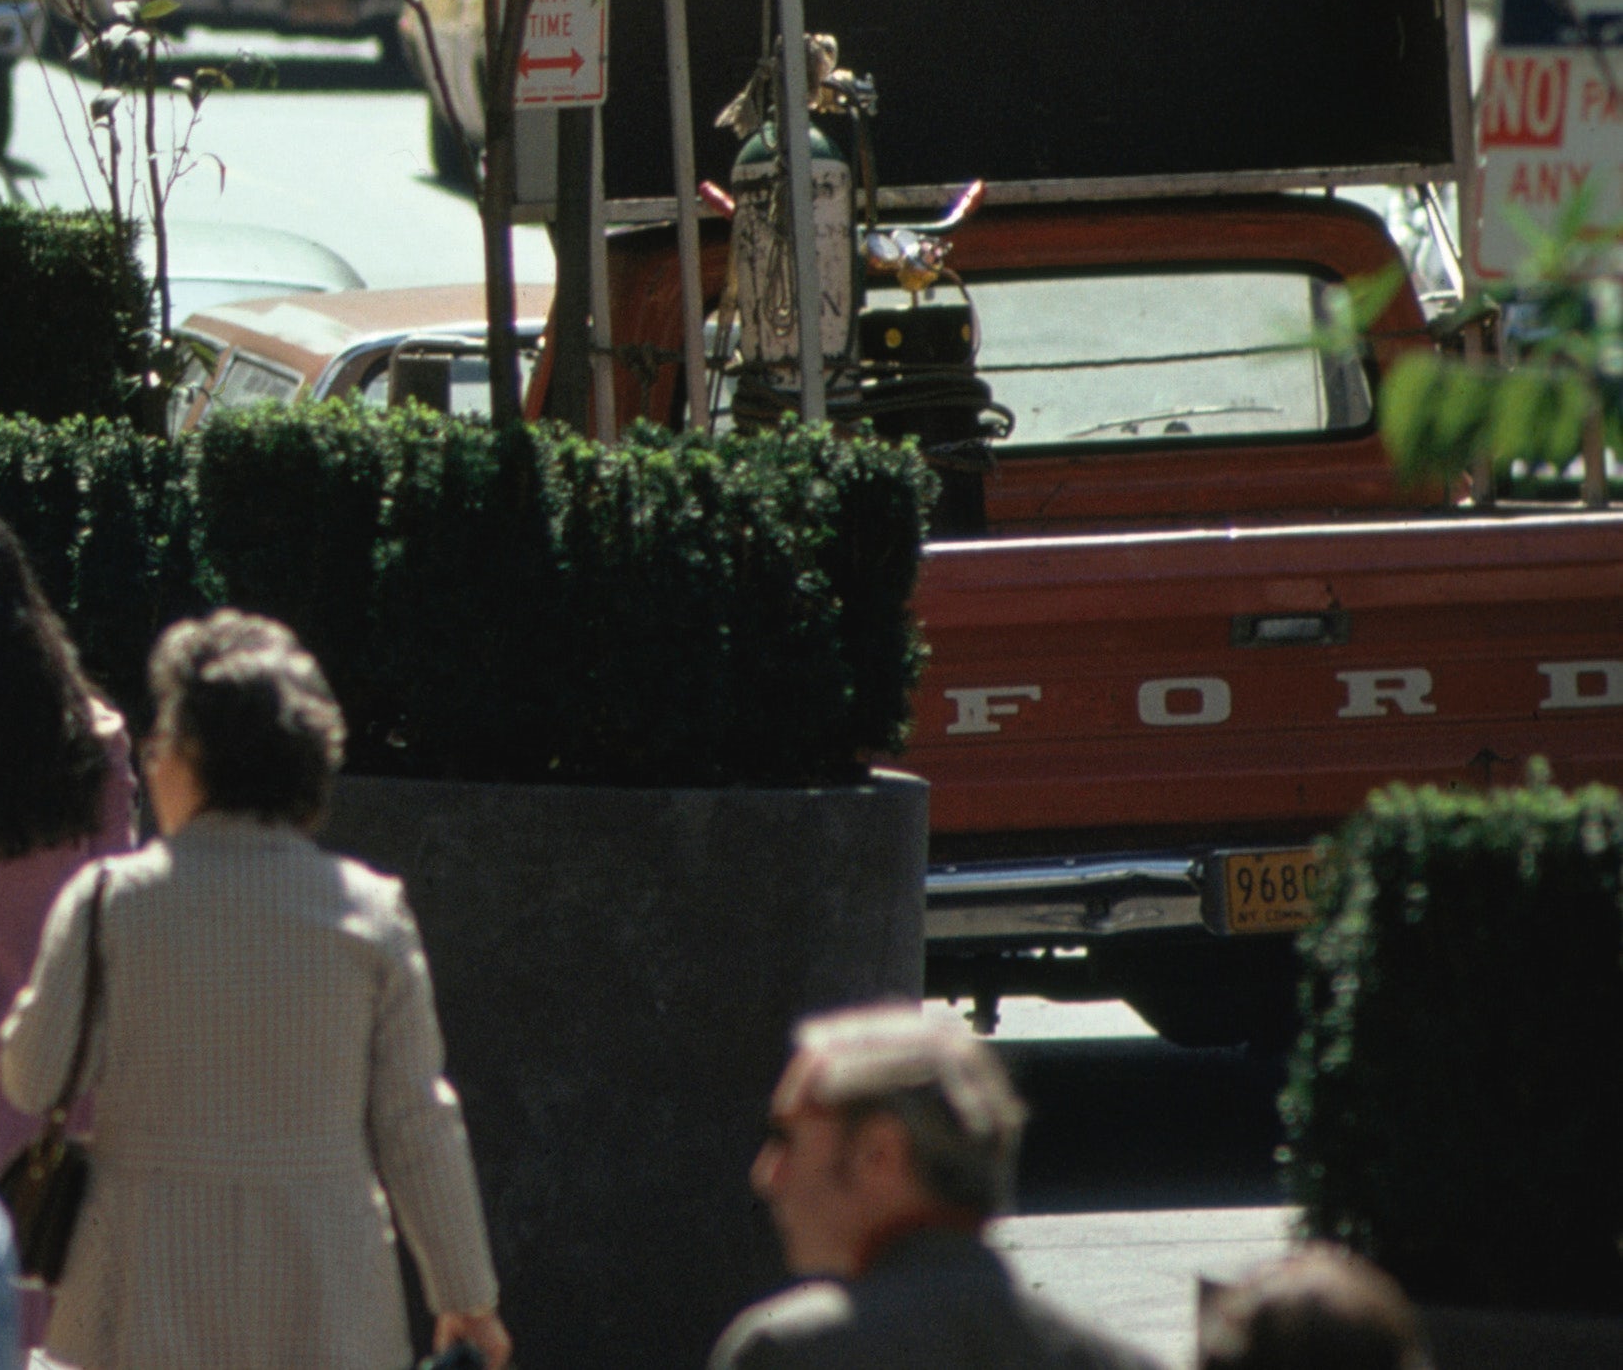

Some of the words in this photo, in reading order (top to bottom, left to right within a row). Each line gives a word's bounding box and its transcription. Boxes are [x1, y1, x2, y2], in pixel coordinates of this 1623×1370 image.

[529, 11, 573, 39] TIME
[1486, 53, 1562, 138] NO
[944, 660, 1623, 735] FORD
